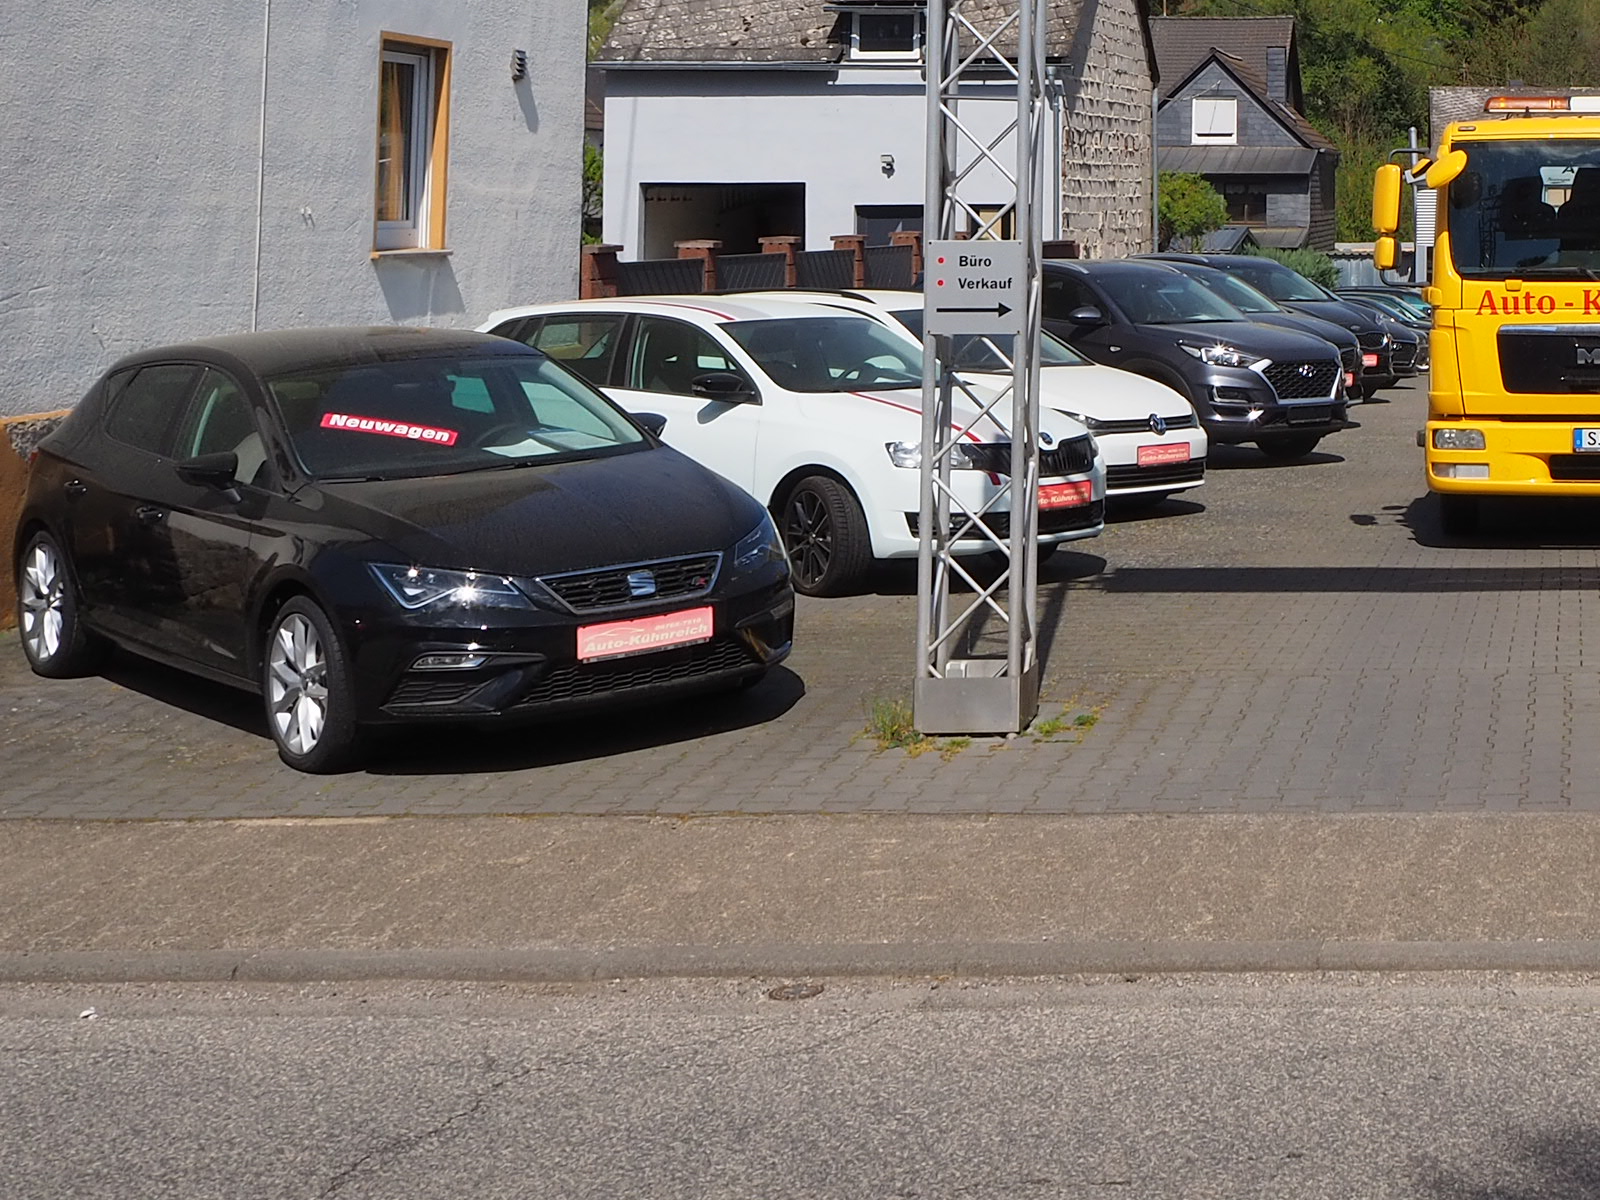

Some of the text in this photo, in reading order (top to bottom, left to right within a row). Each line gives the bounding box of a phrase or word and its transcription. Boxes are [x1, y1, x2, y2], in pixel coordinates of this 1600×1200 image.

[959, 255, 992, 267] Büro
[958, 277, 1013, 289] Verkauf
[1476, 289, 1556, 316] Auto
[329, 413, 450, 442] Neuwagen
[583, 623, 708, 654] Auto-Kühnreich
